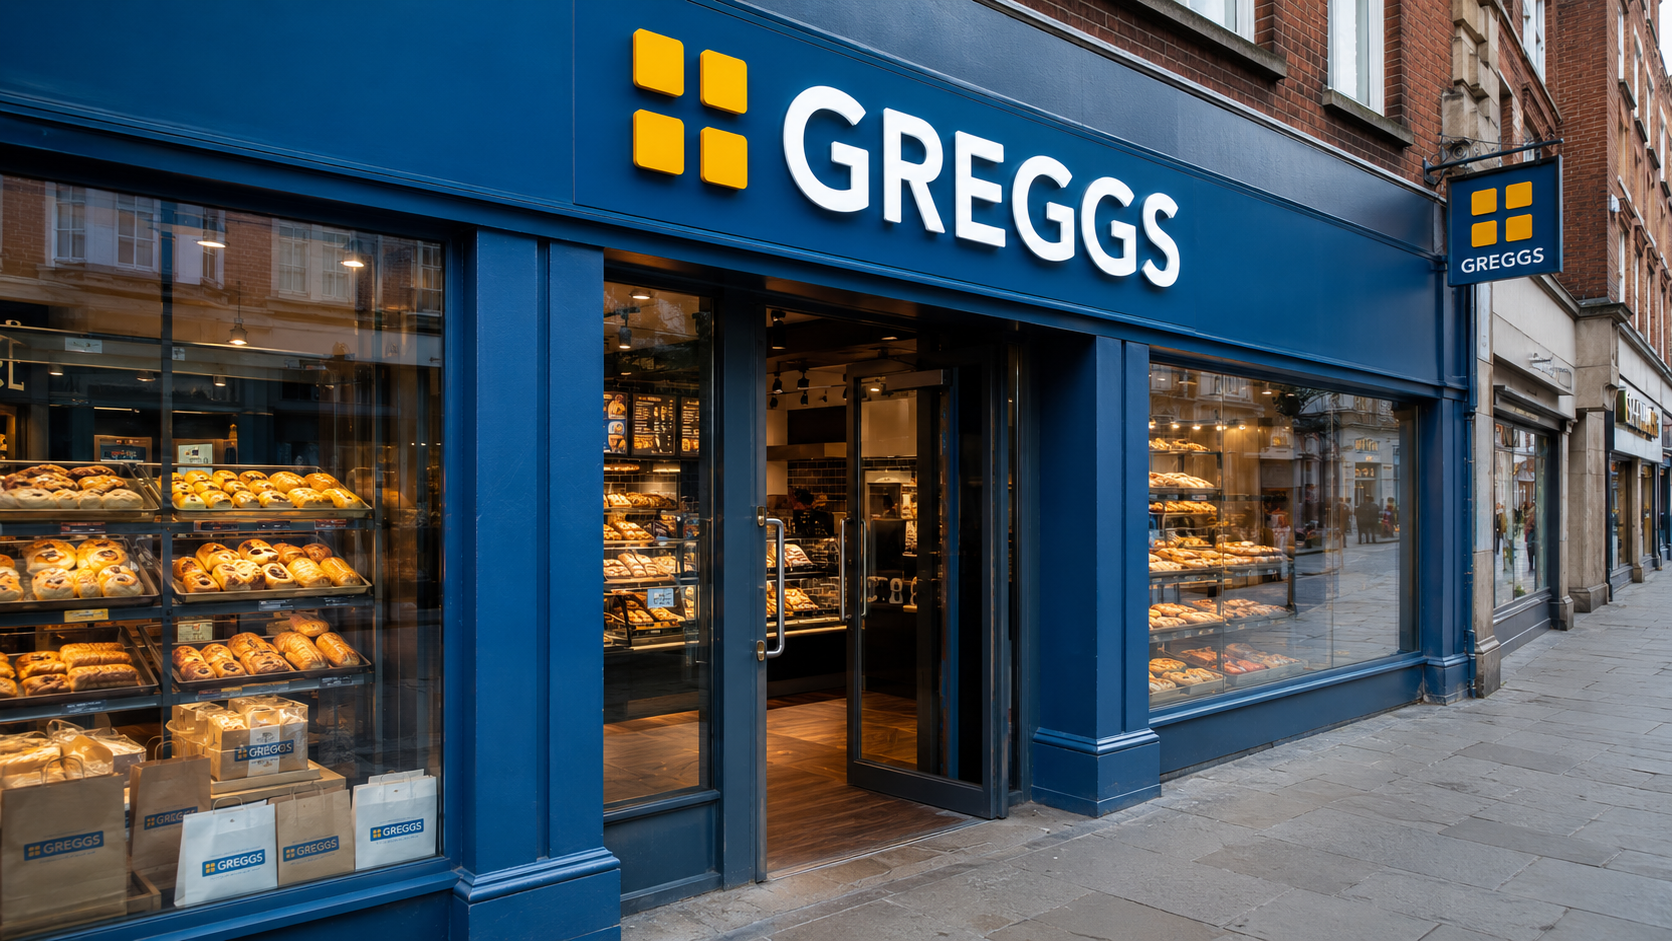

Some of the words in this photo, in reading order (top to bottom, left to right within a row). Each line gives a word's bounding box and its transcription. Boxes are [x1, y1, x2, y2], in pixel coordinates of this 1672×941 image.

[783, 85, 1181, 288] GREGGS
[1461, 247, 1544, 273] GREGGS
[382, 821, 422, 836] GREGGS
[43, 834, 101, 854] GREGGS
[296, 838, 337, 856] GREGGS
[217, 852, 263, 871] GREGGS
